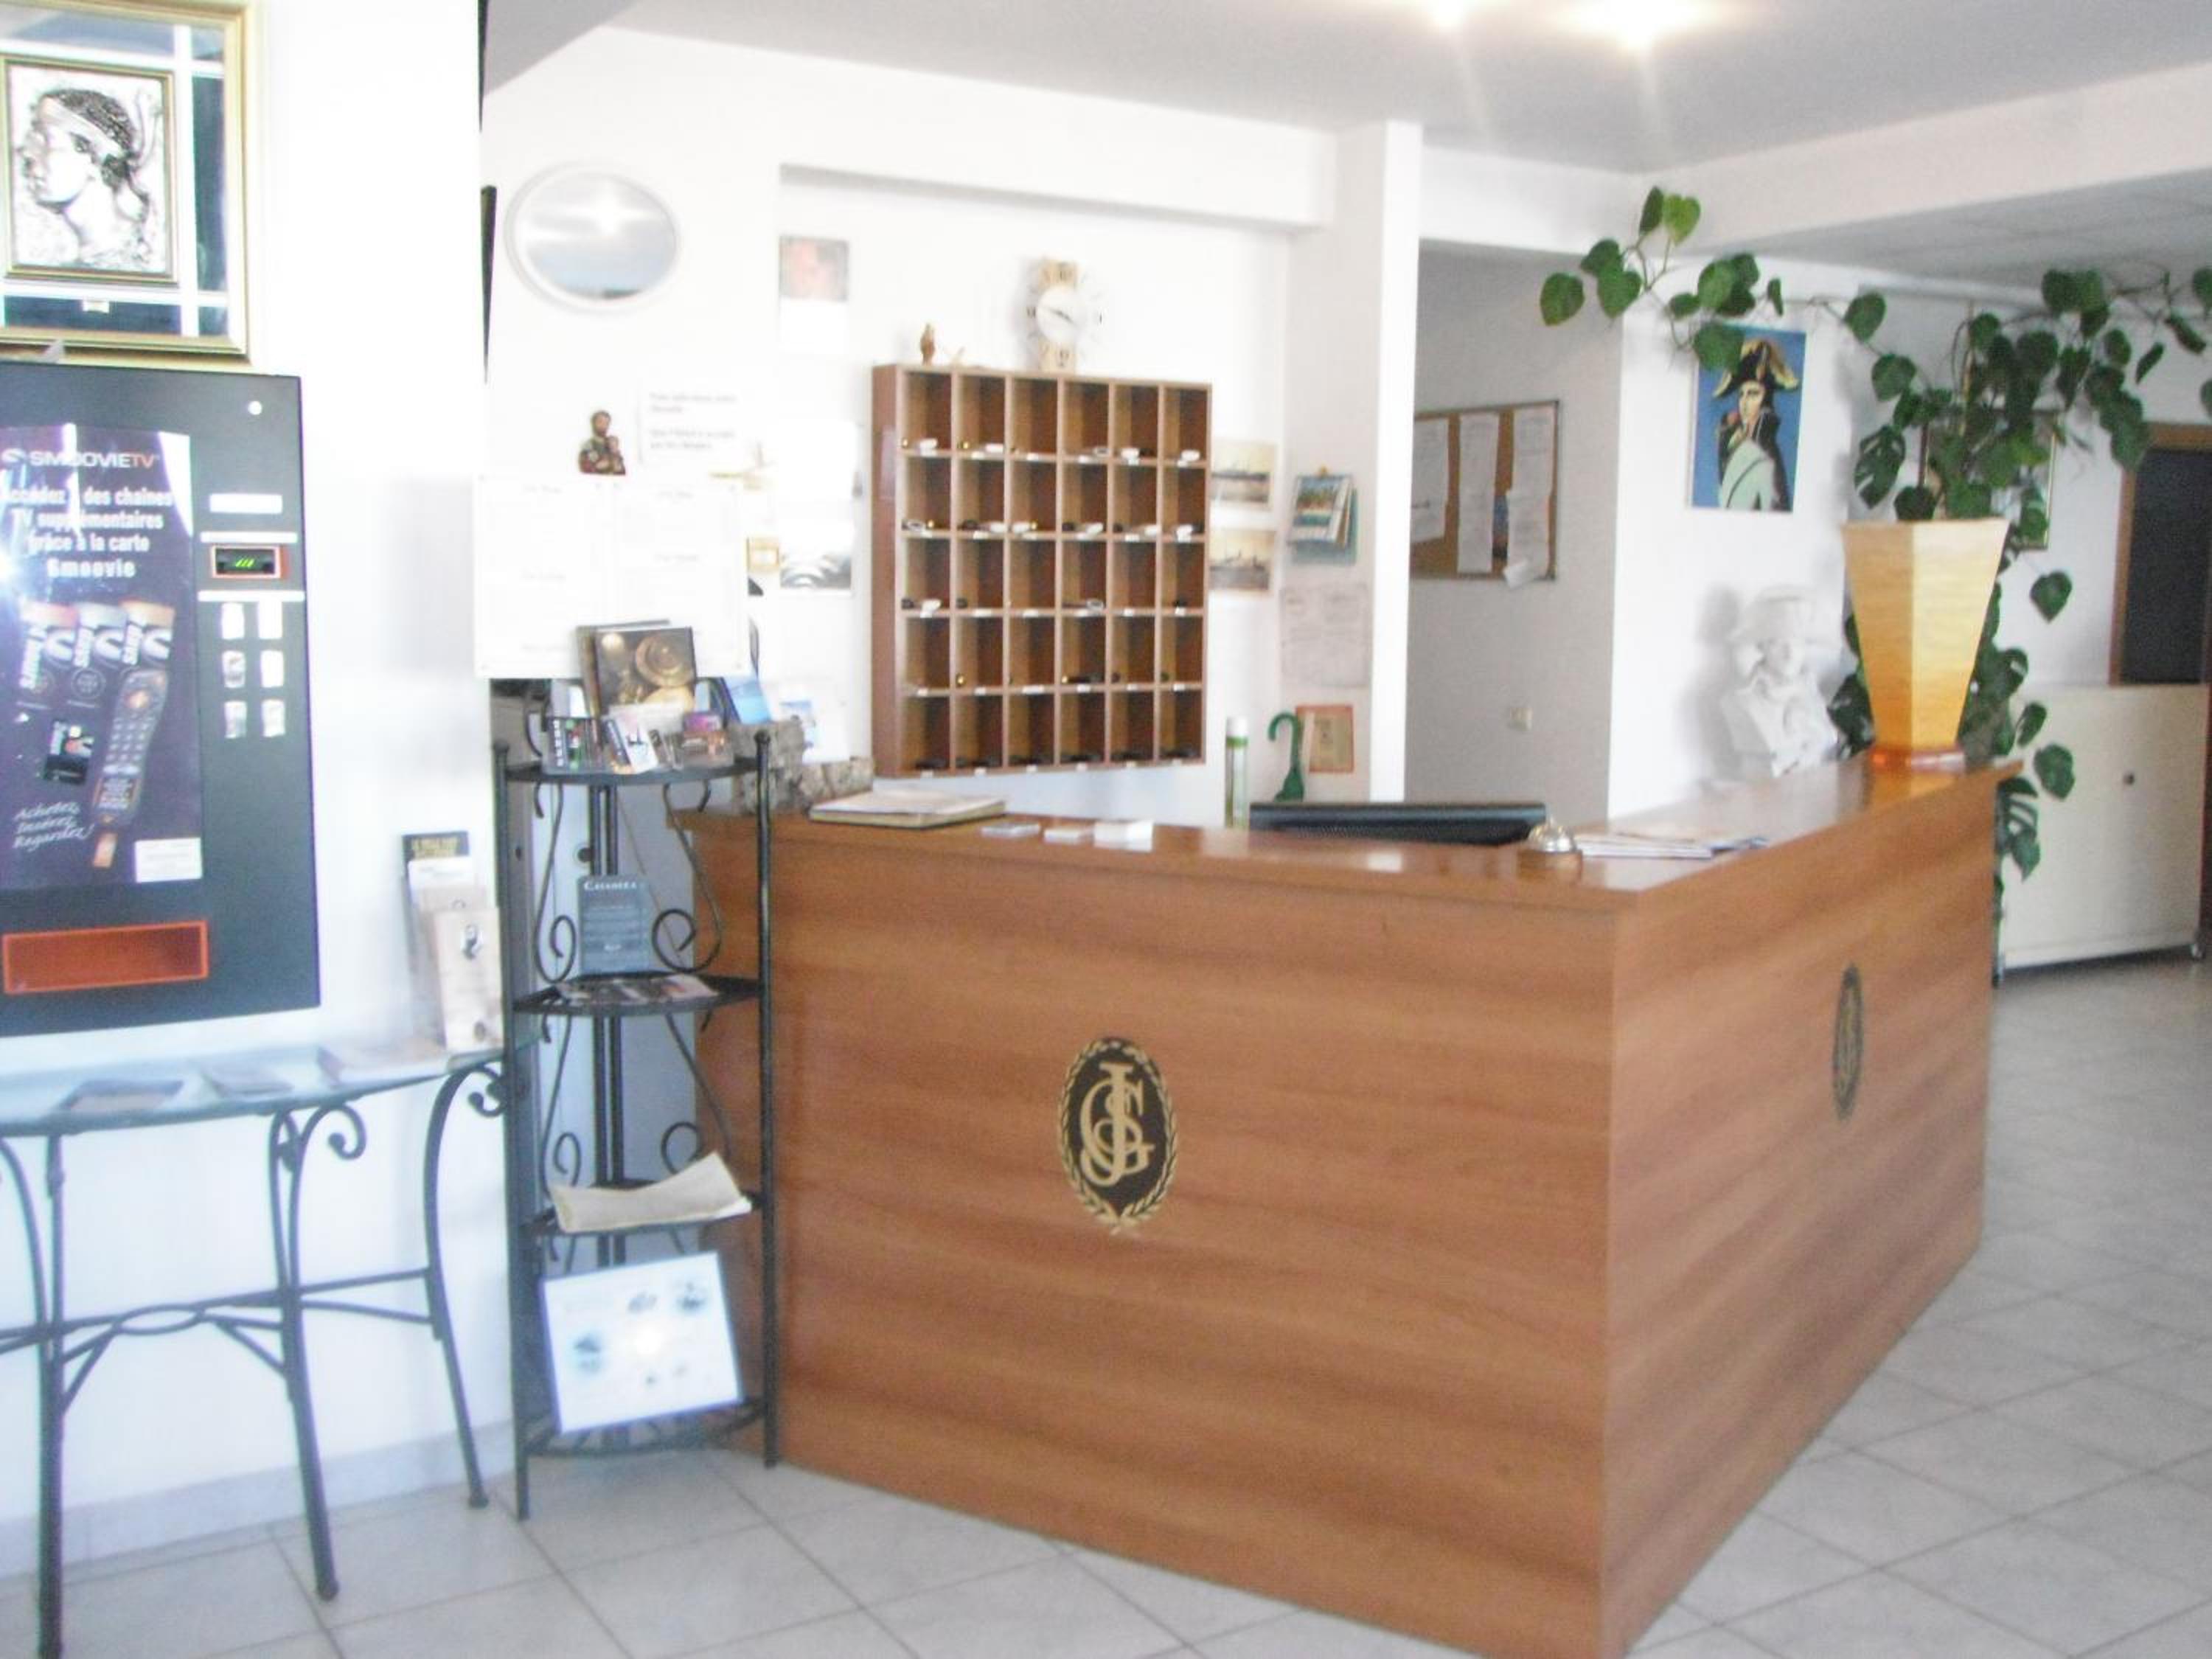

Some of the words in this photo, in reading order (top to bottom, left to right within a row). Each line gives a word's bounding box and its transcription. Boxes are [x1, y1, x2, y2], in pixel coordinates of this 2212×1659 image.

[84, 485, 111, 506] des
[90, 532, 105, 552] la
[108, 534, 150, 552] carte
[46, 557, 136, 578] Smoovie
